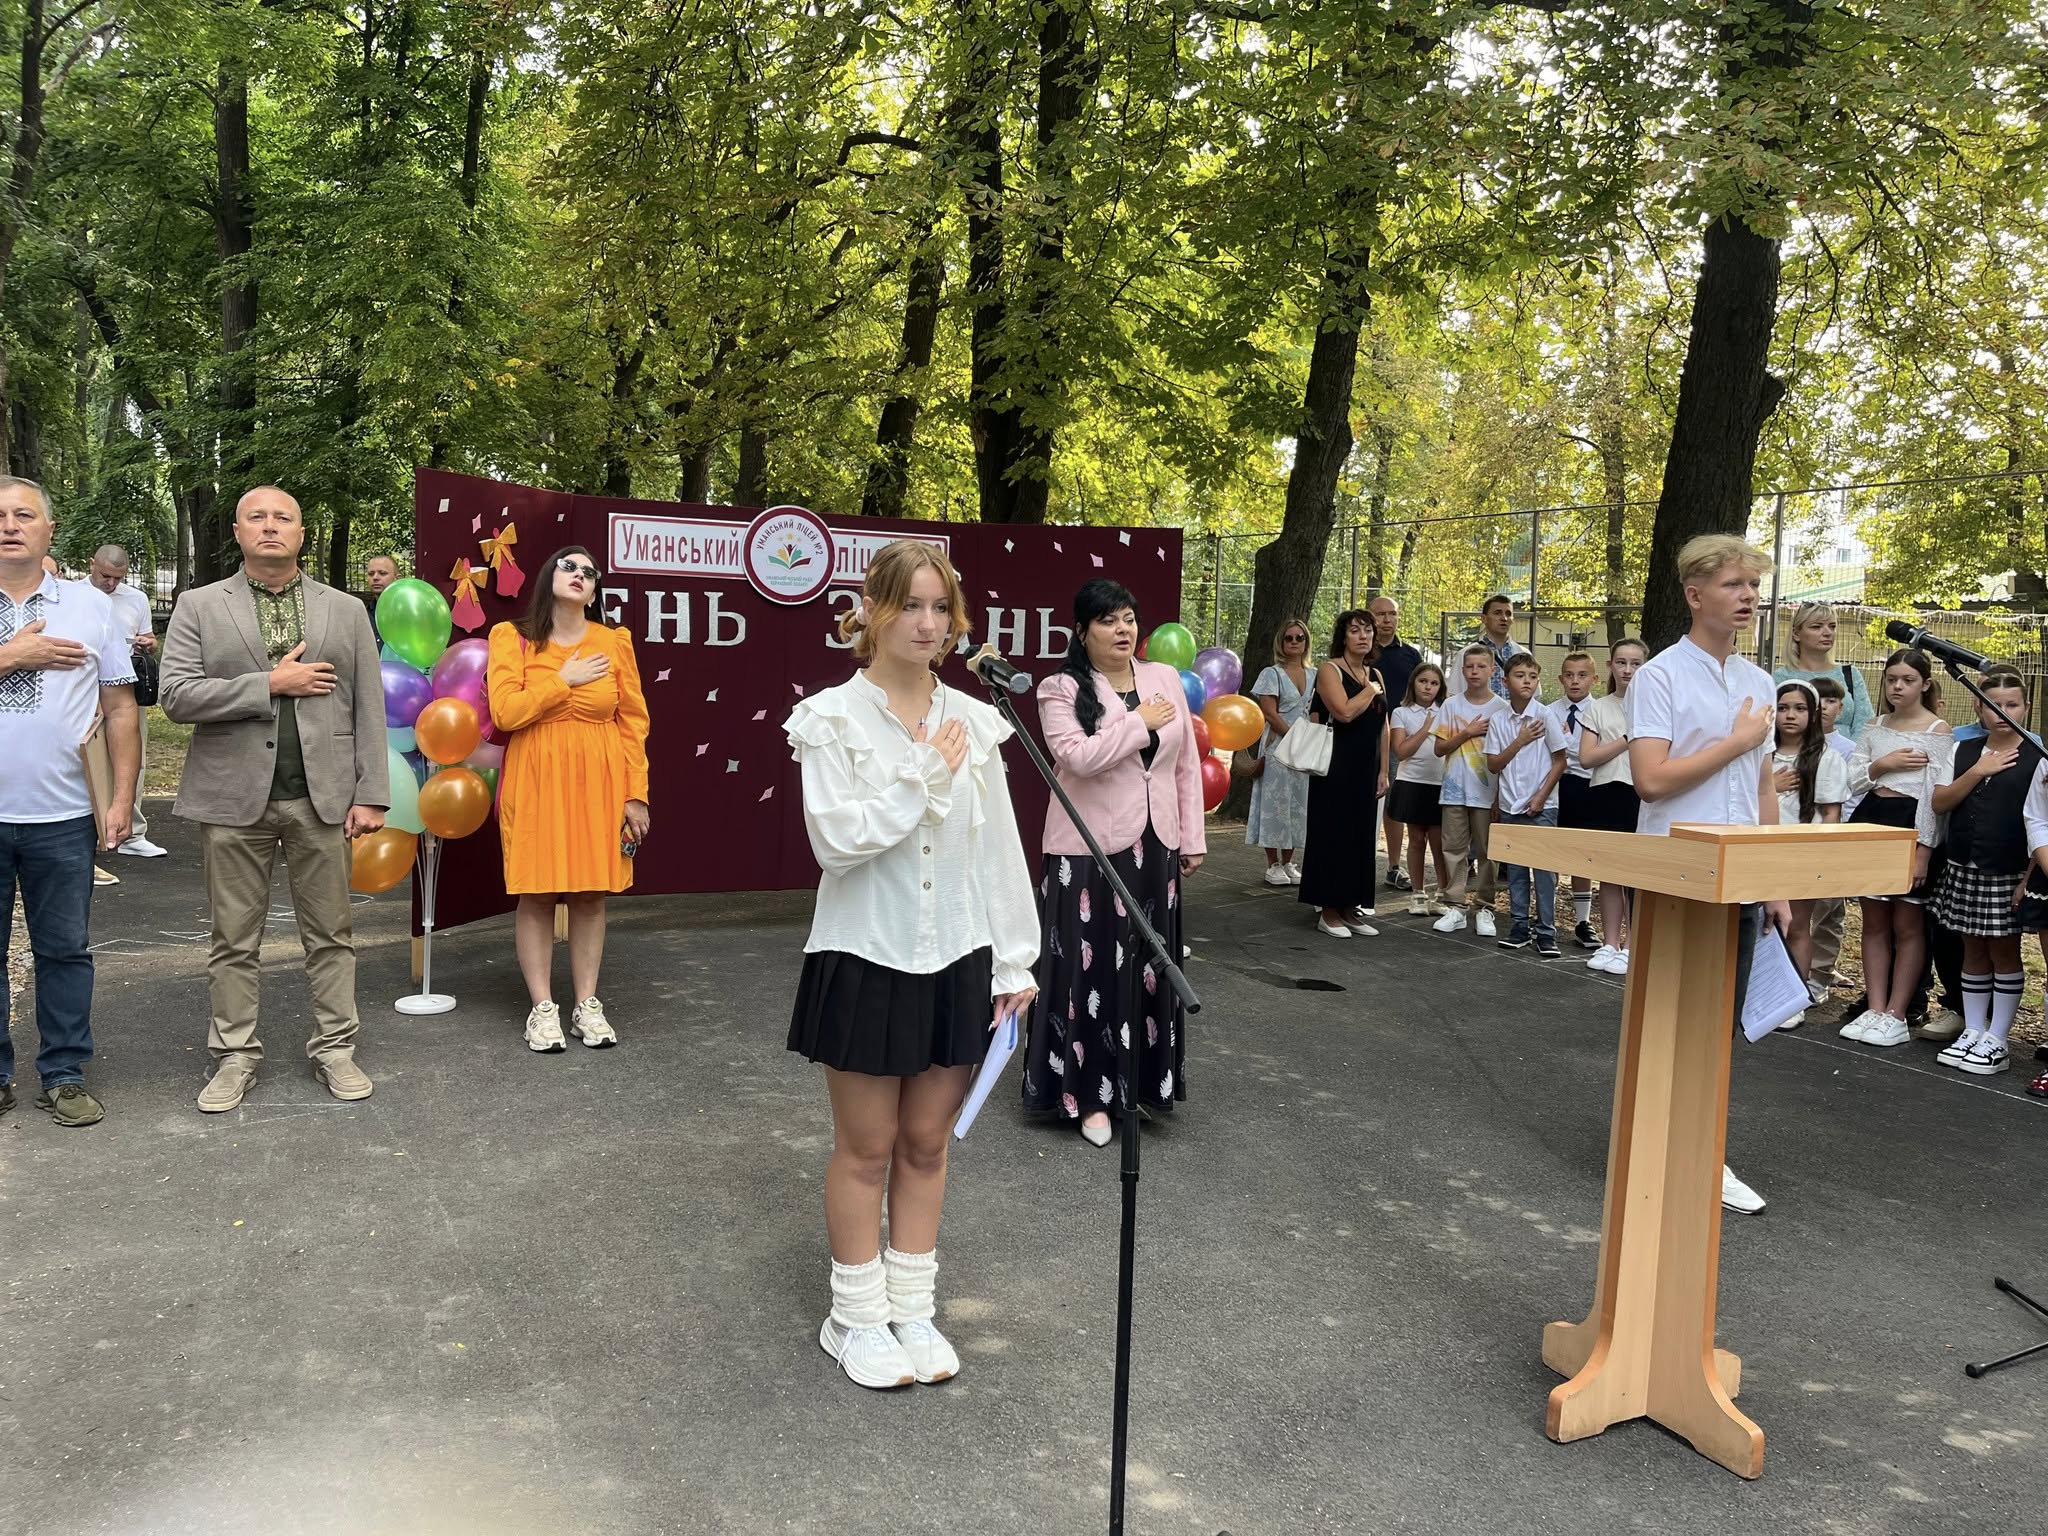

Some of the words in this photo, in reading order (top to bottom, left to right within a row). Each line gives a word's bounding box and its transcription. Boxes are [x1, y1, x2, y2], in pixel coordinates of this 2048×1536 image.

[622, 523, 739, 566] Уманський
[756, 519, 794, 549] УМАНСЬКИЙ
[796, 522, 817, 542] ЛІЦЕЙ
[600, 587, 747, 646] ЕНЬ
[825, 590, 1073, 658] ЗНЬ
